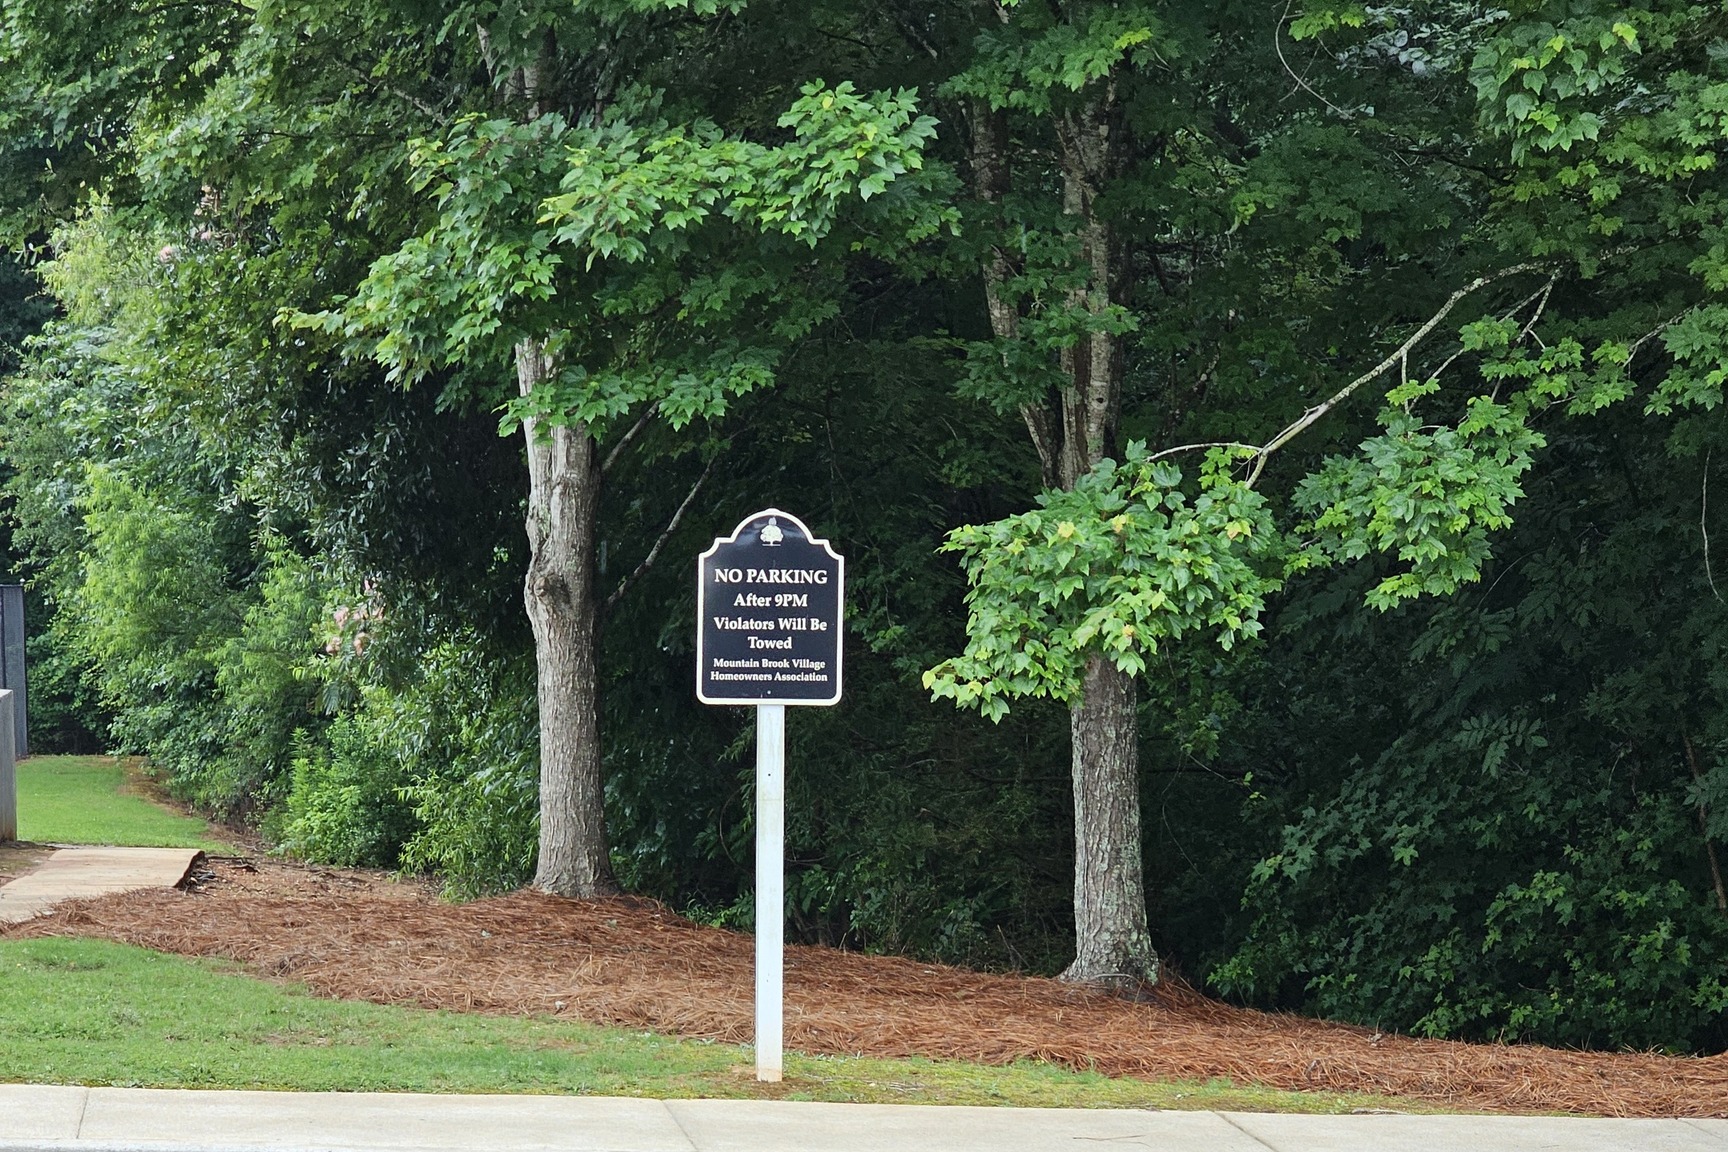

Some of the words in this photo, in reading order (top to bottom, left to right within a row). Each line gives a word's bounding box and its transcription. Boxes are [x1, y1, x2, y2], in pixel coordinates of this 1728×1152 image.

[714, 568, 743, 583] NO
[746, 569, 828, 584] PARKING
[733, 593, 772, 607] After
[774, 594, 808, 607] 9PM
[713, 617, 775, 630] Violators
[778, 618, 806, 630] Will
[810, 618, 828, 631] Be
[747, 636, 793, 649] Towed
[713, 658, 759, 668] Mountain
[761, 658, 790, 668] Brook
[792, 658, 826, 671] Village
[710, 671, 772, 681] Homeowners
[773, 671, 828, 682] Association
